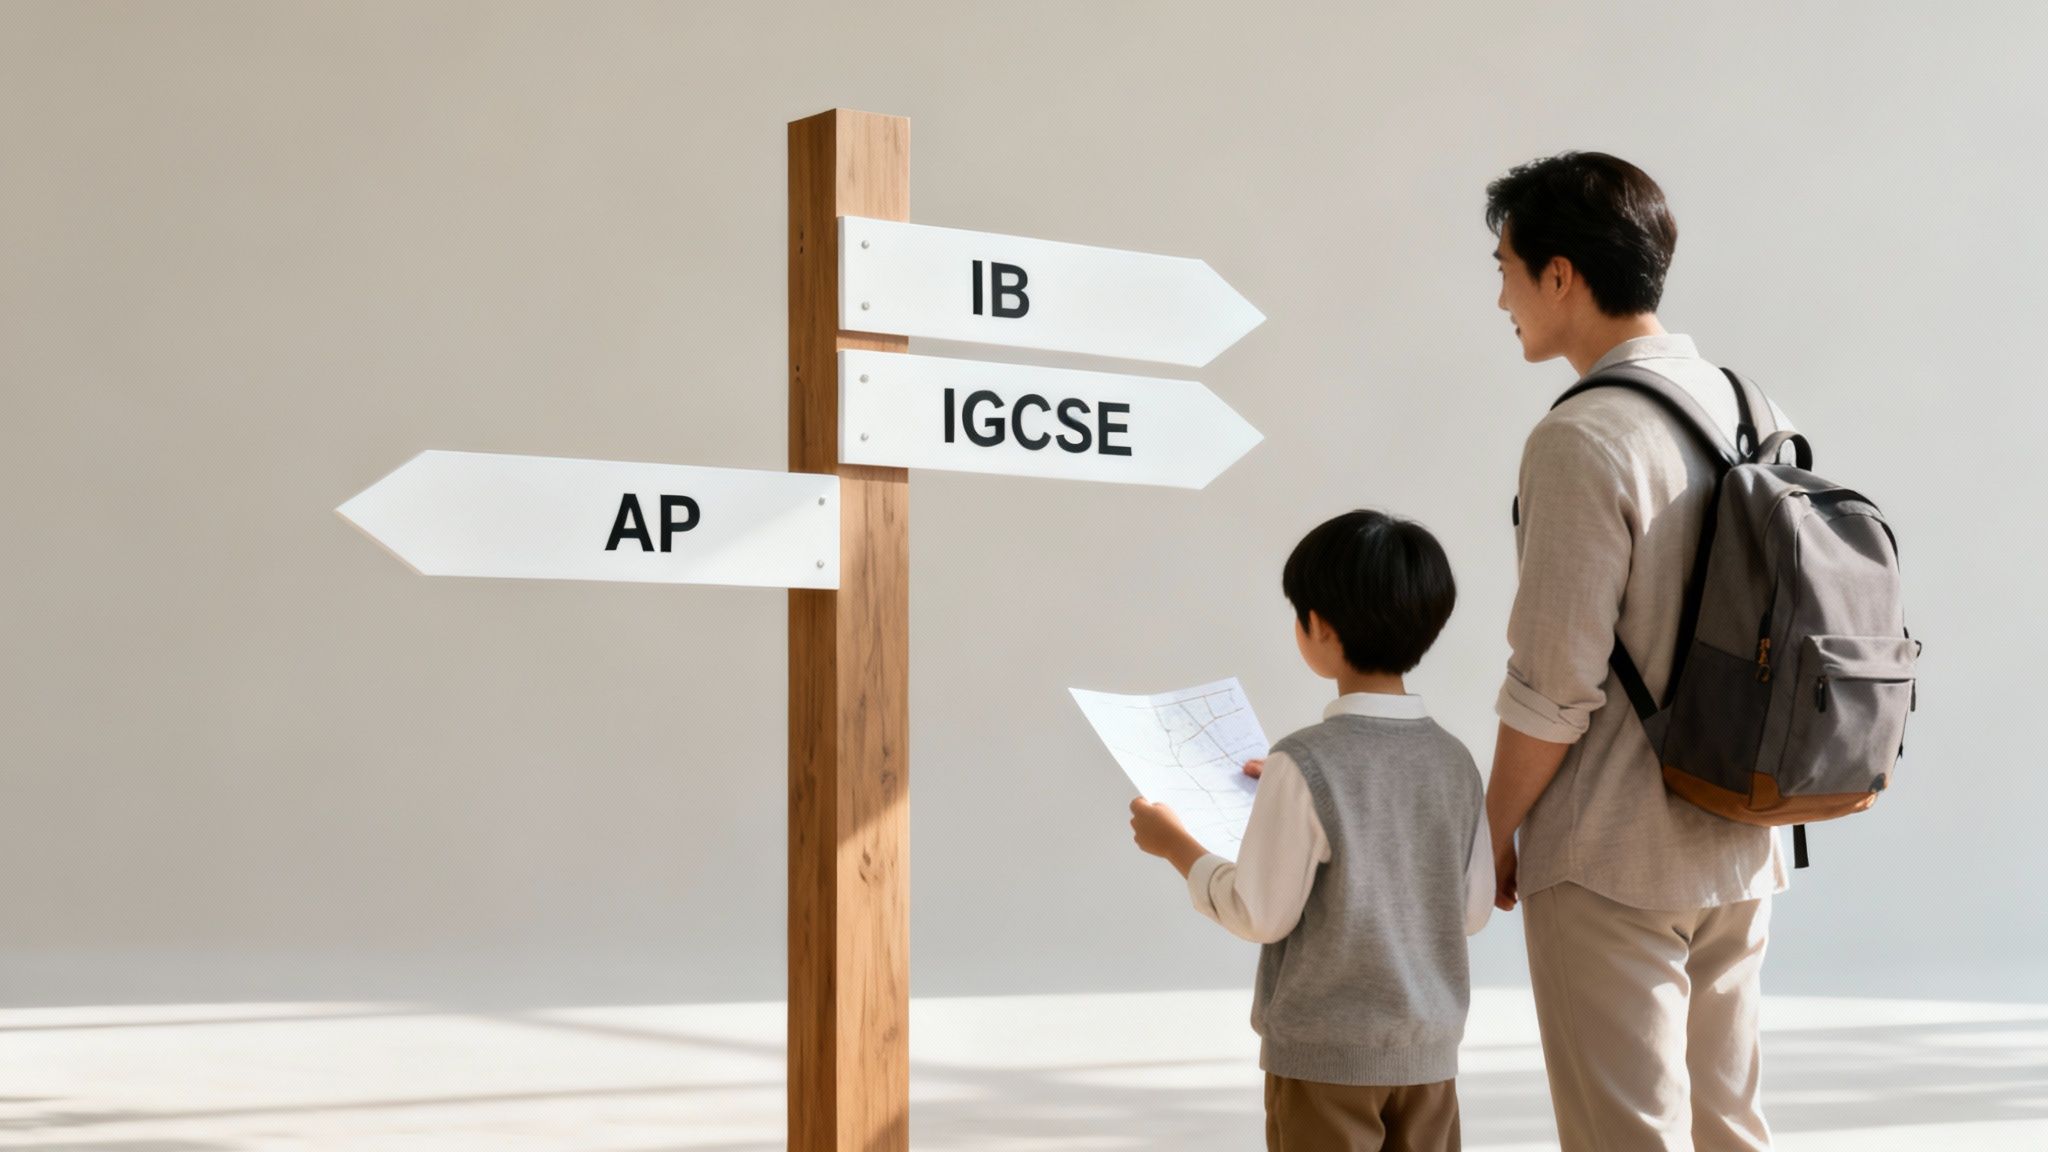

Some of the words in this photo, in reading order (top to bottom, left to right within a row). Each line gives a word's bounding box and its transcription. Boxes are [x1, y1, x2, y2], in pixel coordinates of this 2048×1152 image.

[972, 259, 1031, 319] IB
[944, 387, 1132, 457] IGCSE
[604, 493, 701, 553] AP
